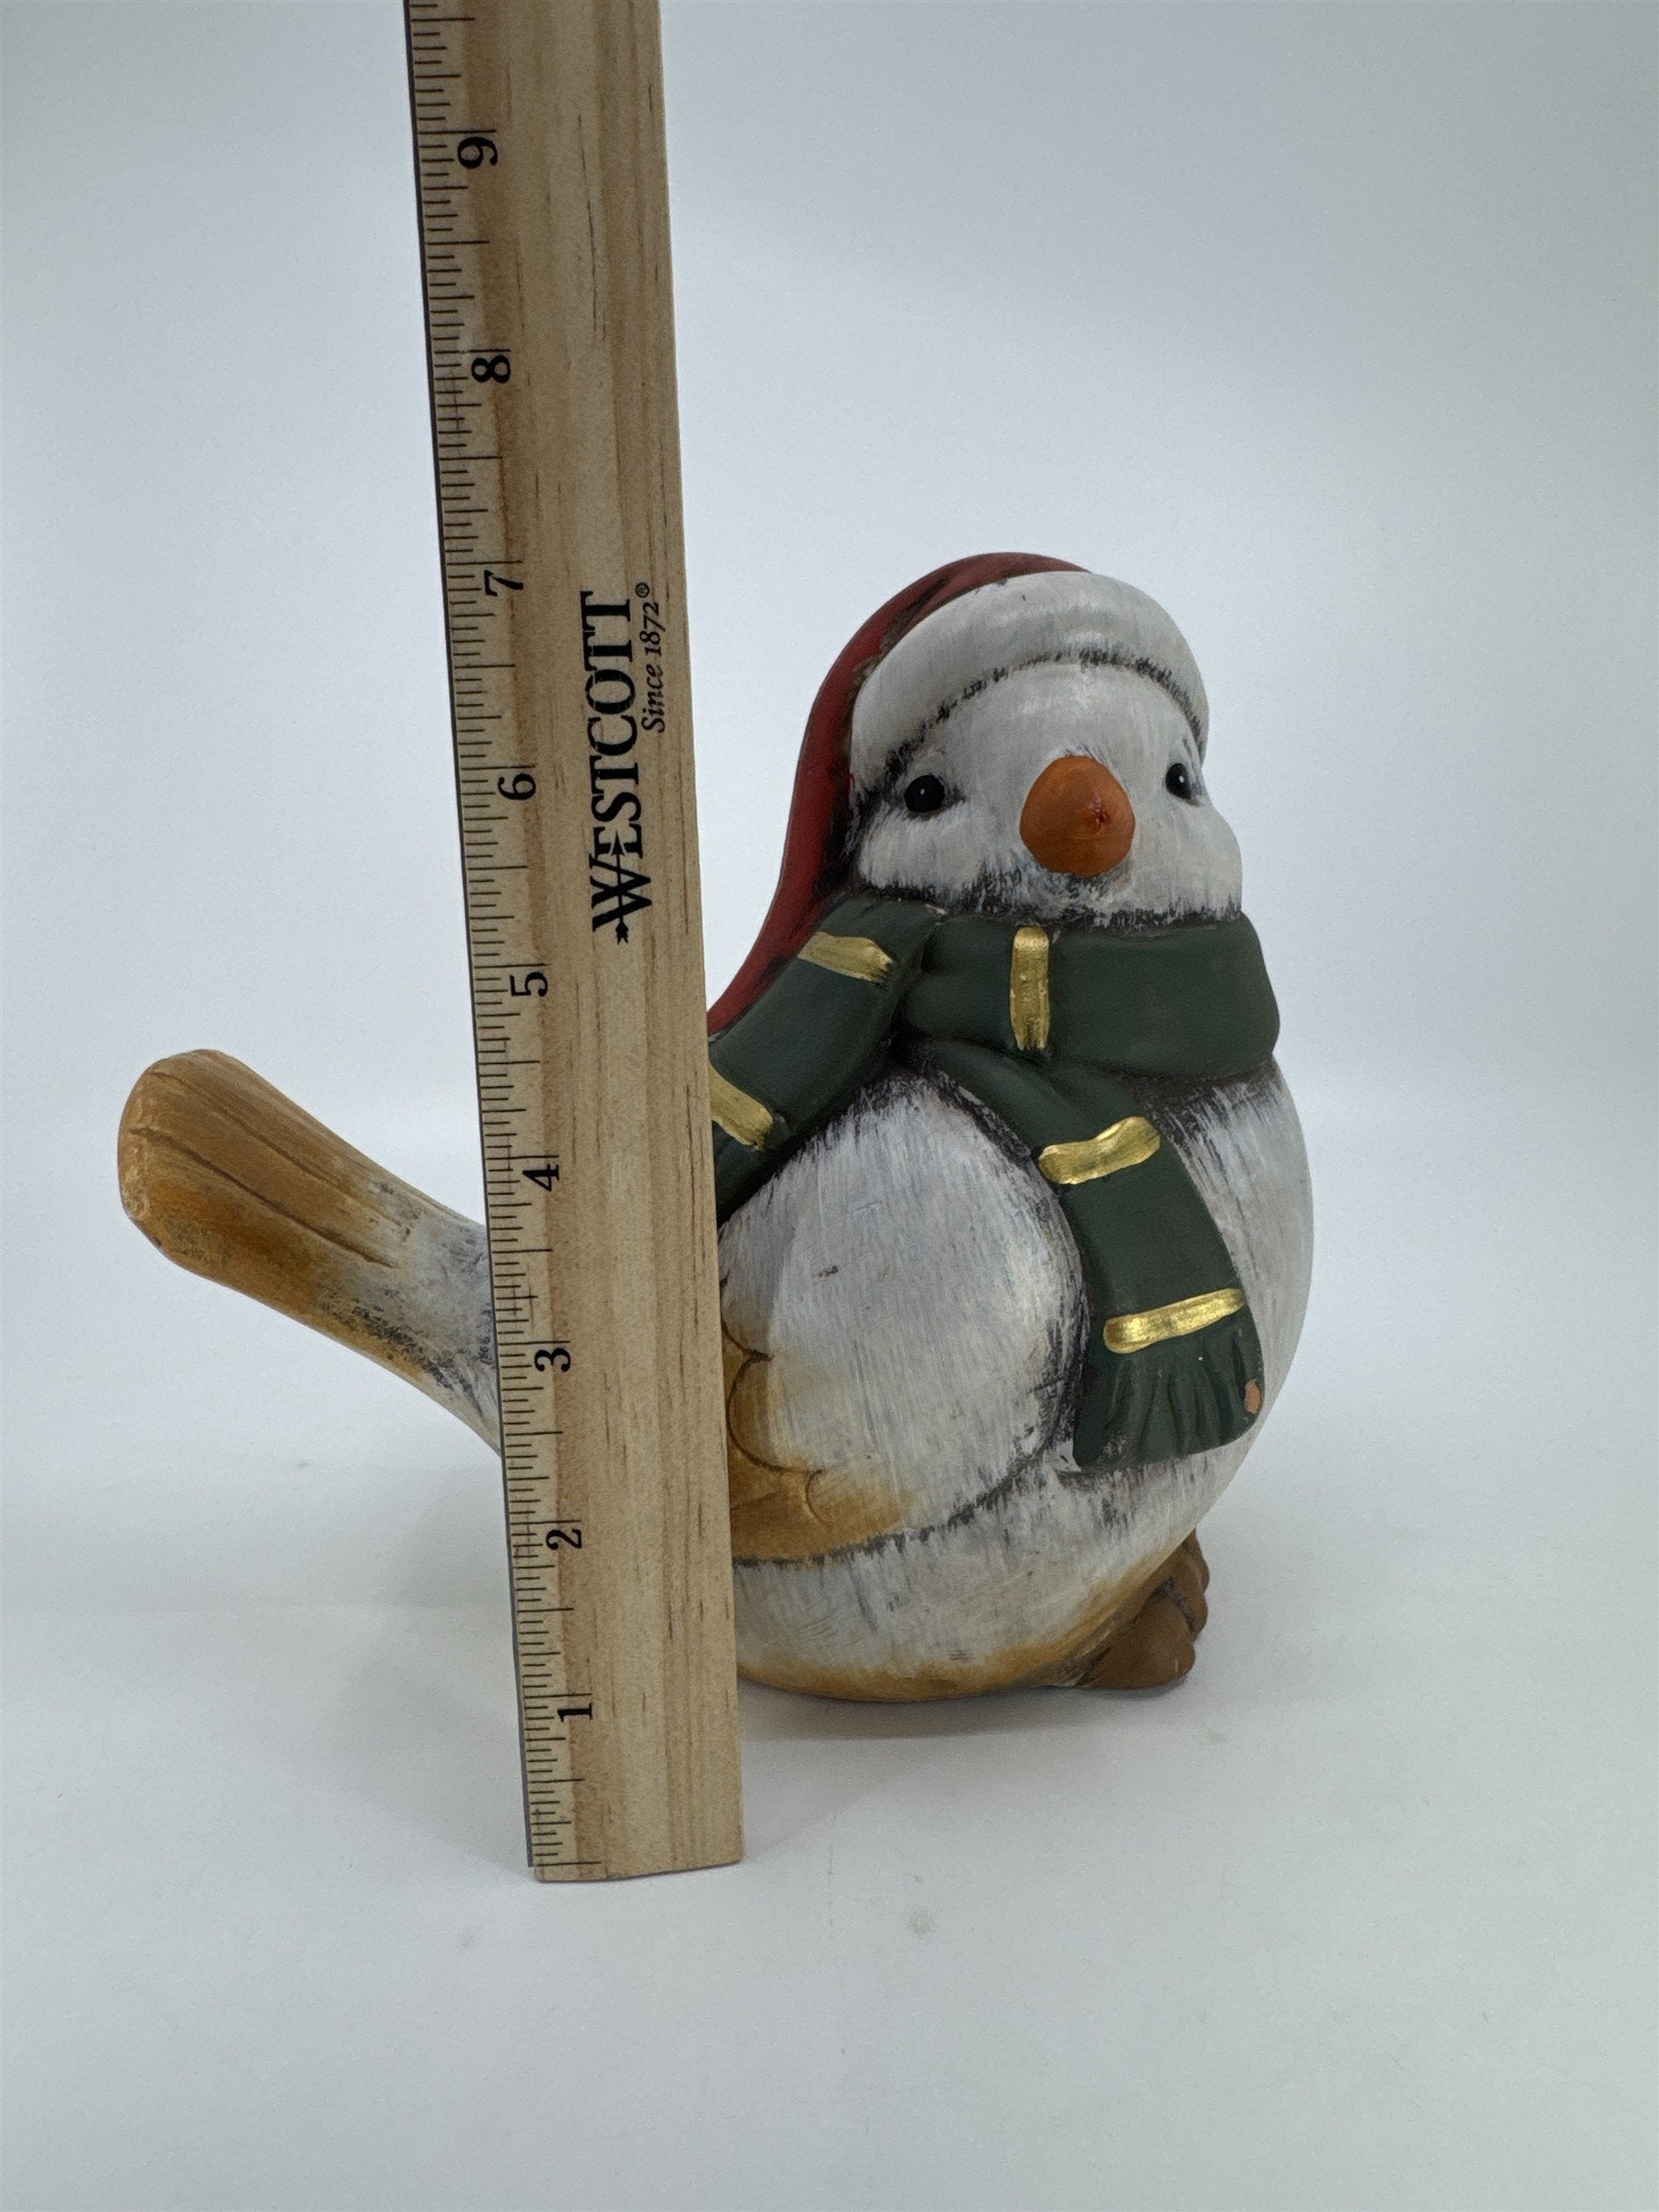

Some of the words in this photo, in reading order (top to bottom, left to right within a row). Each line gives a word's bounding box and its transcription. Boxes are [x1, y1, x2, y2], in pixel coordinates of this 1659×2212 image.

[456, 135, 499, 170] 9
[470, 354, 512, 384] 8
[484, 569, 524, 597] 7
[641, 663, 666, 735] Since
[579, 590, 653, 933] WESTCOTT
[498, 771, 536, 801] 6
[510, 968, 549, 998] 5
[522, 1160, 561, 1194] 4
[534, 1345, 572, 1373] 3
[545, 1526, 583, 1551] 2
[556, 1700, 594, 1724] 1
